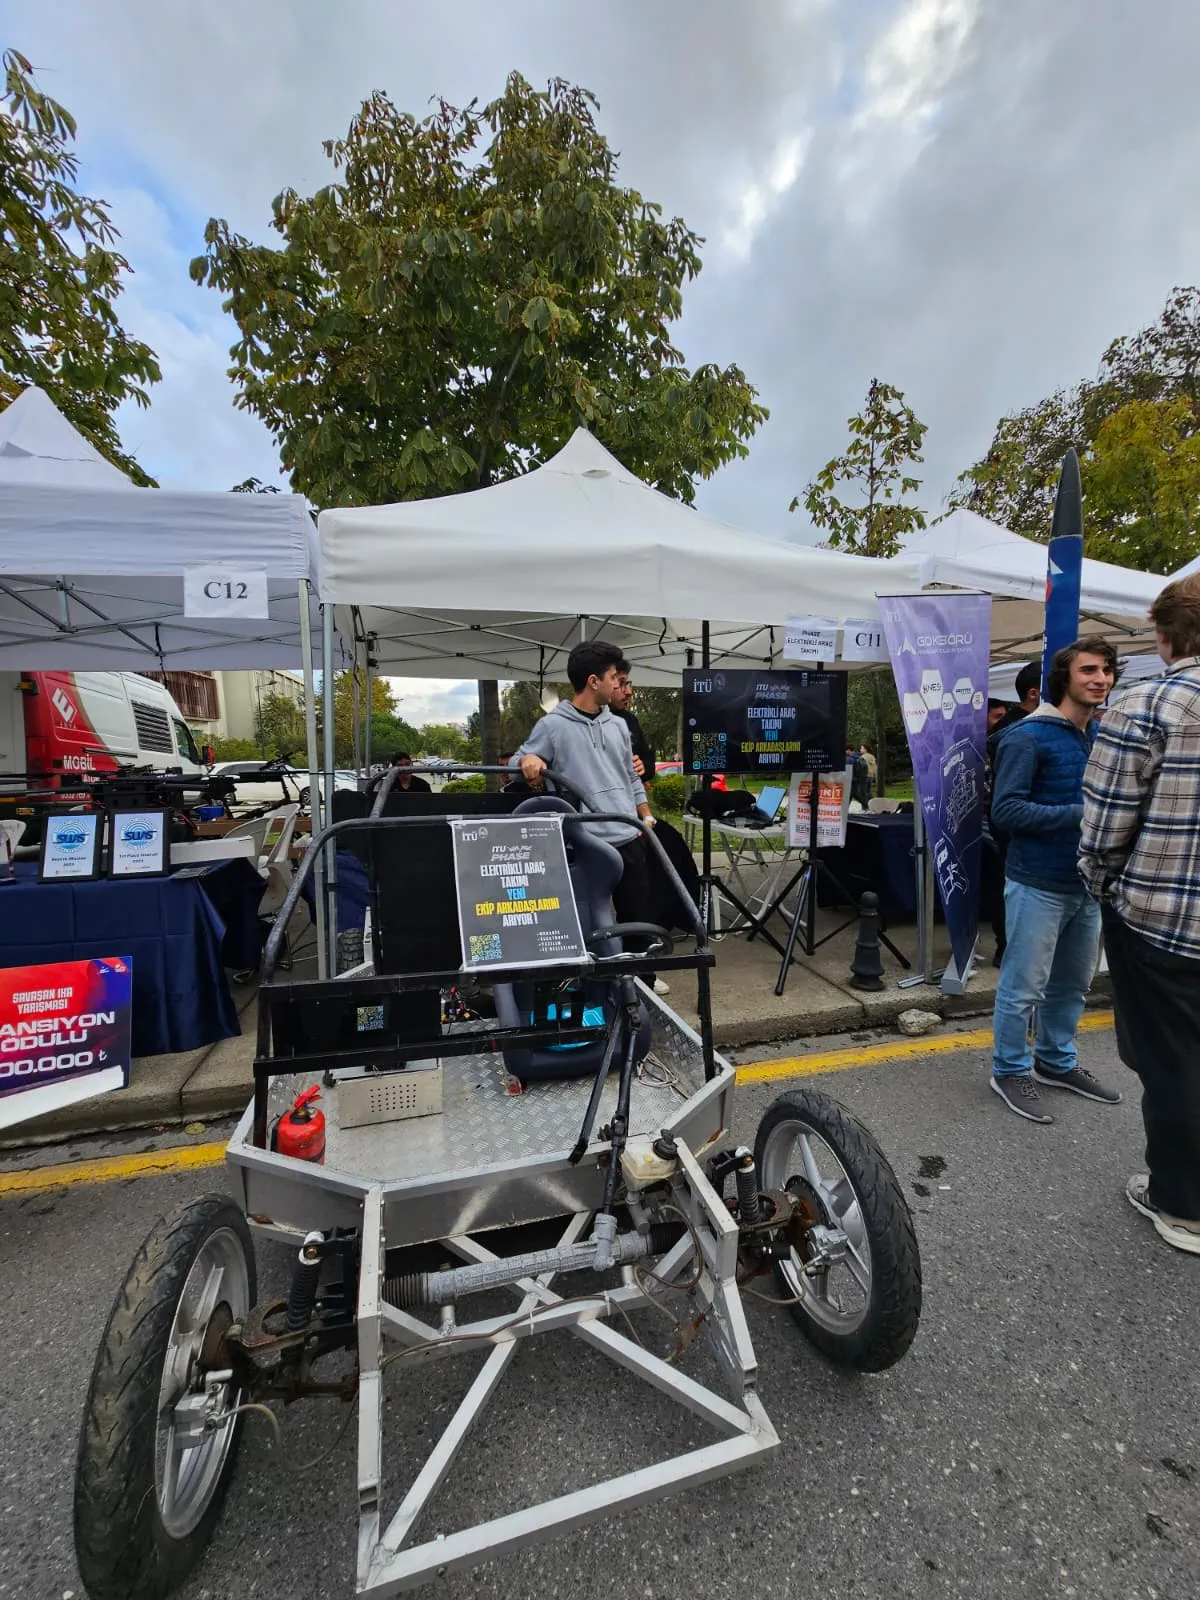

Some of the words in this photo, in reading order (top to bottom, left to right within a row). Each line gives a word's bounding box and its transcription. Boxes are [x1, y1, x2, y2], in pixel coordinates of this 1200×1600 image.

[204, 581, 248, 599] C12
[855, 632, 881, 648] C11
[694, 678, 712, 693] İTÜ
[747, 706, 779, 719] ELEKTRİKLİ
[780, 707, 796, 720] ARAÇ
[63, 753, 96, 771] MOBİL
[490, 852, 530, 861] PHASE
[480, 862, 523, 877] ELEKTRİKLİ
[524, 861, 546, 875] ARAÇ
[475, 901, 495, 916] EKİP
[496, 897, 560, 914] ARKADAŞLARINI
[502, 913, 534, 927] ARIYOR
[12, 989, 56, 1004] SAVAŞAN
[18, 999, 68, 1015] YARIŞMASI
